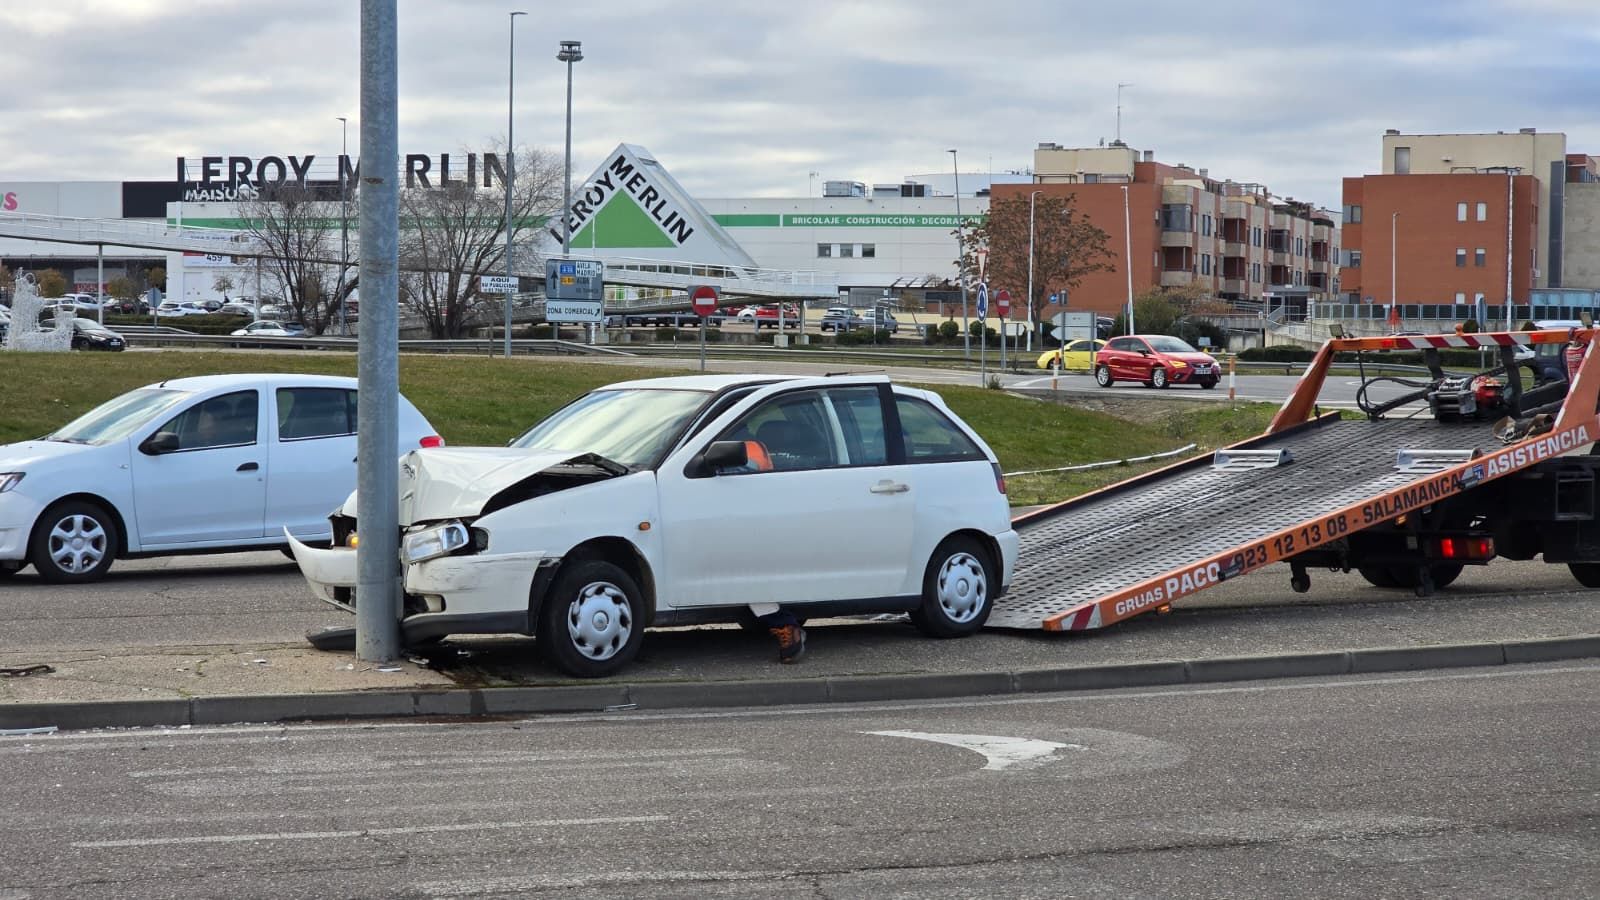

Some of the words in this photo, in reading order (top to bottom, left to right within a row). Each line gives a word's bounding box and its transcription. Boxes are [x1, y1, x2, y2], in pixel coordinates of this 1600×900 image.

[176, 155, 316, 191] LEROY
[338, 152, 515, 189] MRLIN
[609, 154, 694, 245] MERLIN
[792, 216, 840, 225] BRICOLAJE
[846, 215, 915, 225] CONSTRUCCIÓN
[564, 307, 594, 315] COMERCIAL
[1114, 586, 1165, 617] GRUAS
[1164, 561, 1222, 600] PACO
[1234, 543, 1269, 572] 923
[1273, 534, 1295, 556] 12
[1300, 523, 1322, 546] 13
[1326, 514, 1348, 538] 08
[1362, 473, 1463, 524] SALAMANCA
[1486, 424, 1590, 479] ASISTENCIA
